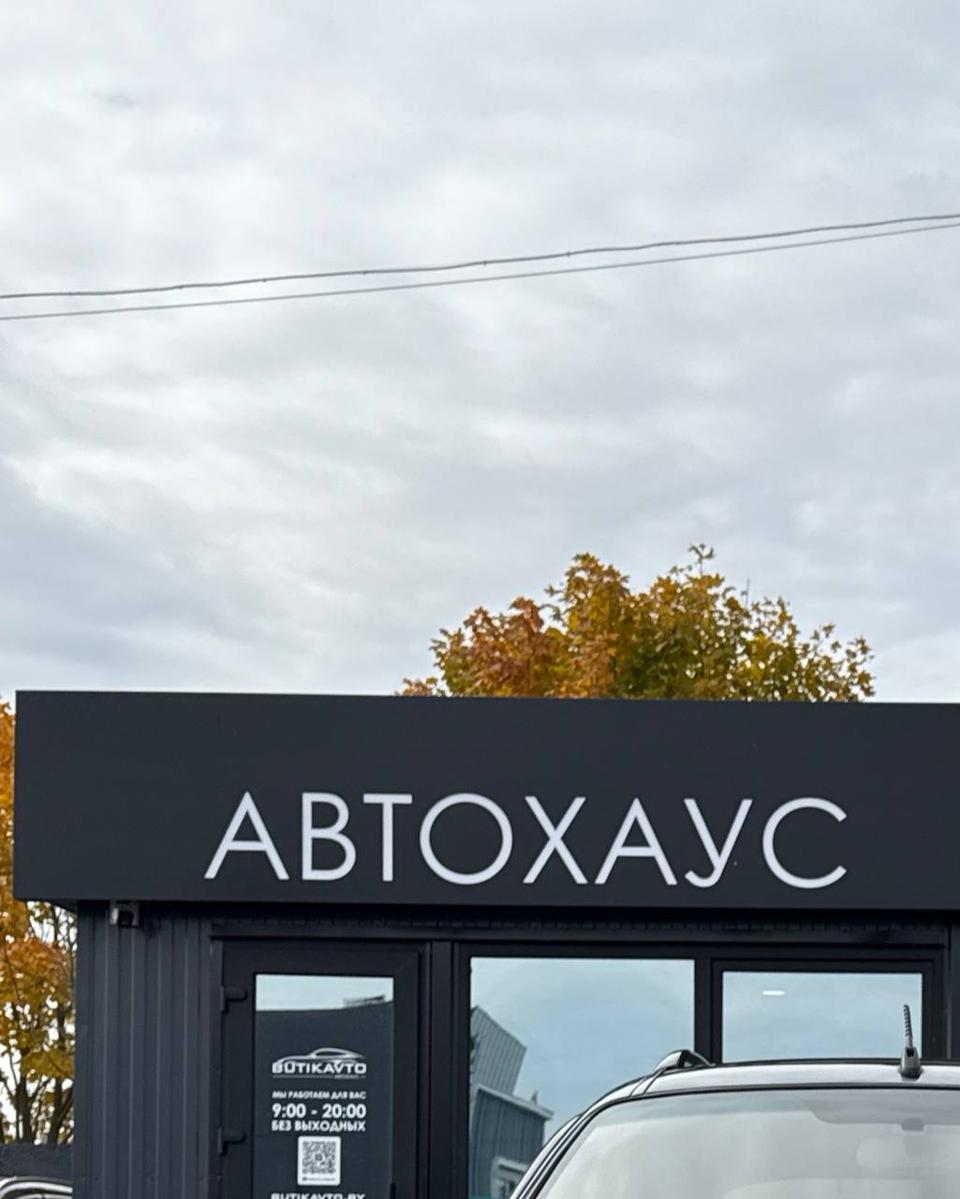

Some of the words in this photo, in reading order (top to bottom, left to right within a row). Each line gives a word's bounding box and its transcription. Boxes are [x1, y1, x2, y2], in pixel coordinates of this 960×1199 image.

[204, 791, 848, 890] АВТОХАУС
[272, 1062, 367, 1075] BUTIKAVTO
[272, 1103, 306, 1118] 9:00
[322, 1103, 367, 1118] 20:00
[272, 1120, 292, 1132] БЕЗ
[294, 1120, 366, 1133] ВЫХОДНЫХ
